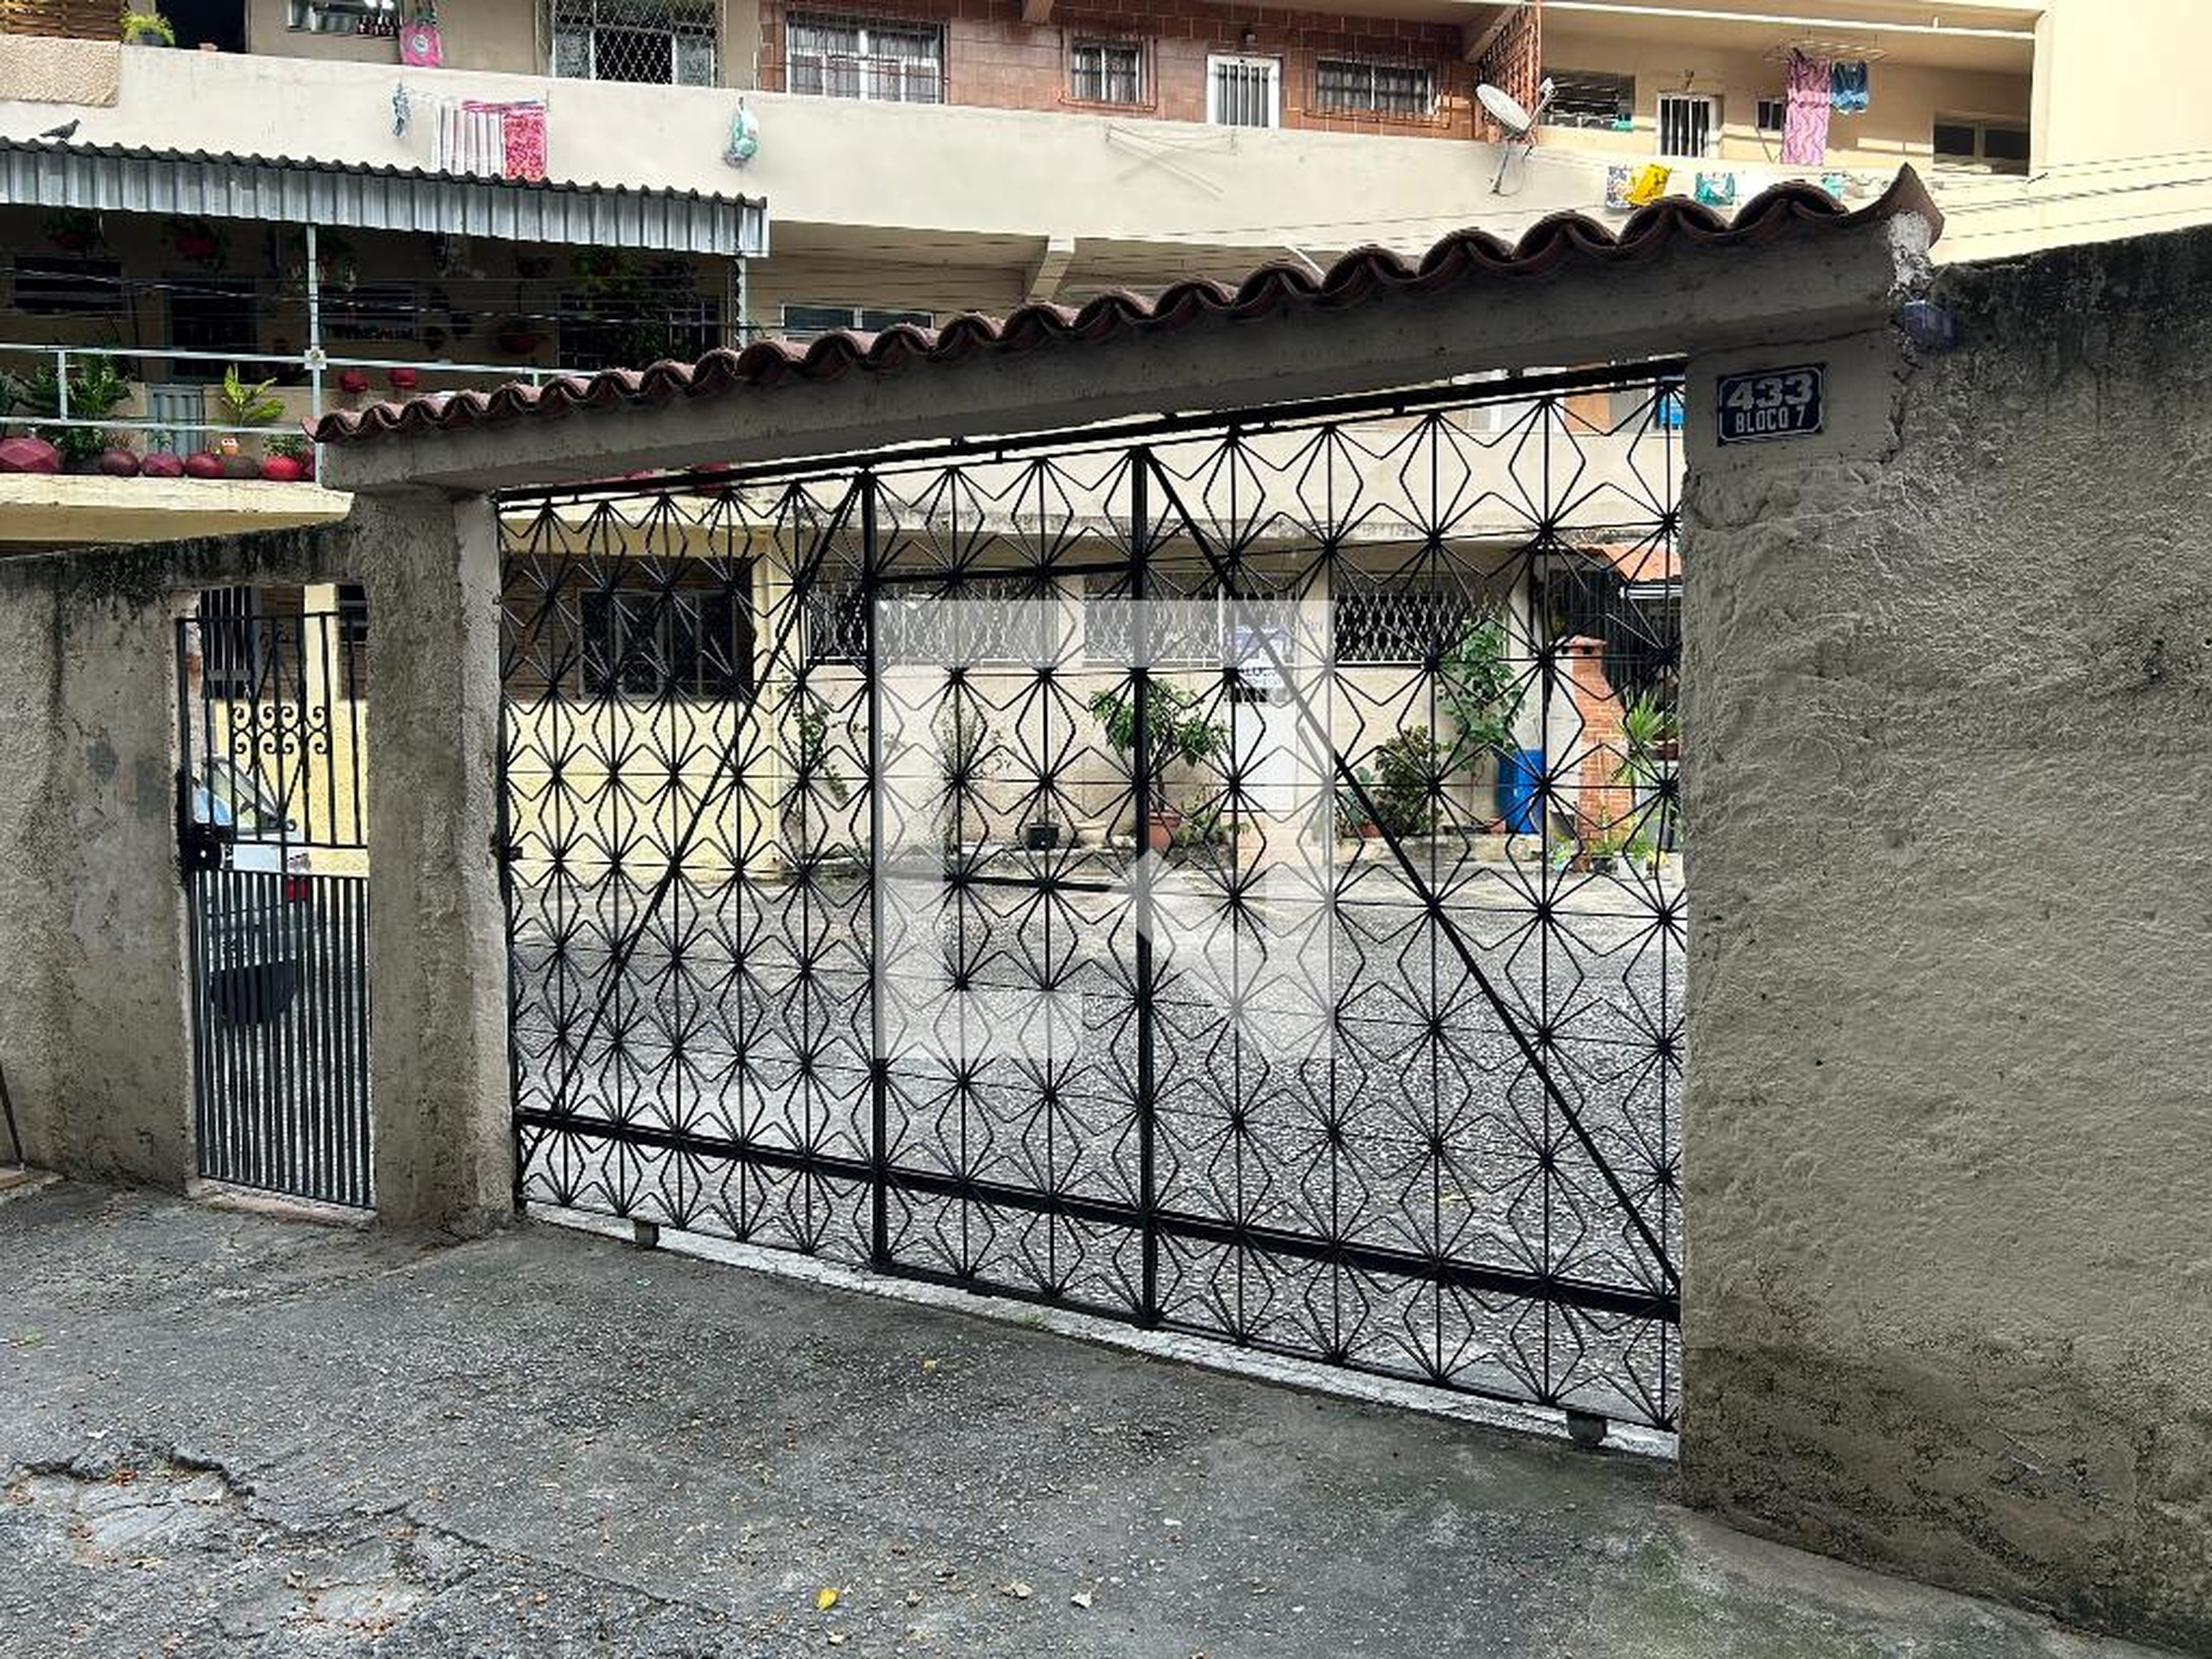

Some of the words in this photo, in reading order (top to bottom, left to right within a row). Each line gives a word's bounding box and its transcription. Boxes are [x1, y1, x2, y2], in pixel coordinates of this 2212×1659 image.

[1728, 374, 1813, 411] 433
[1736, 406, 1789, 433] BLOCO
[1796, 405, 1805, 427] 7
